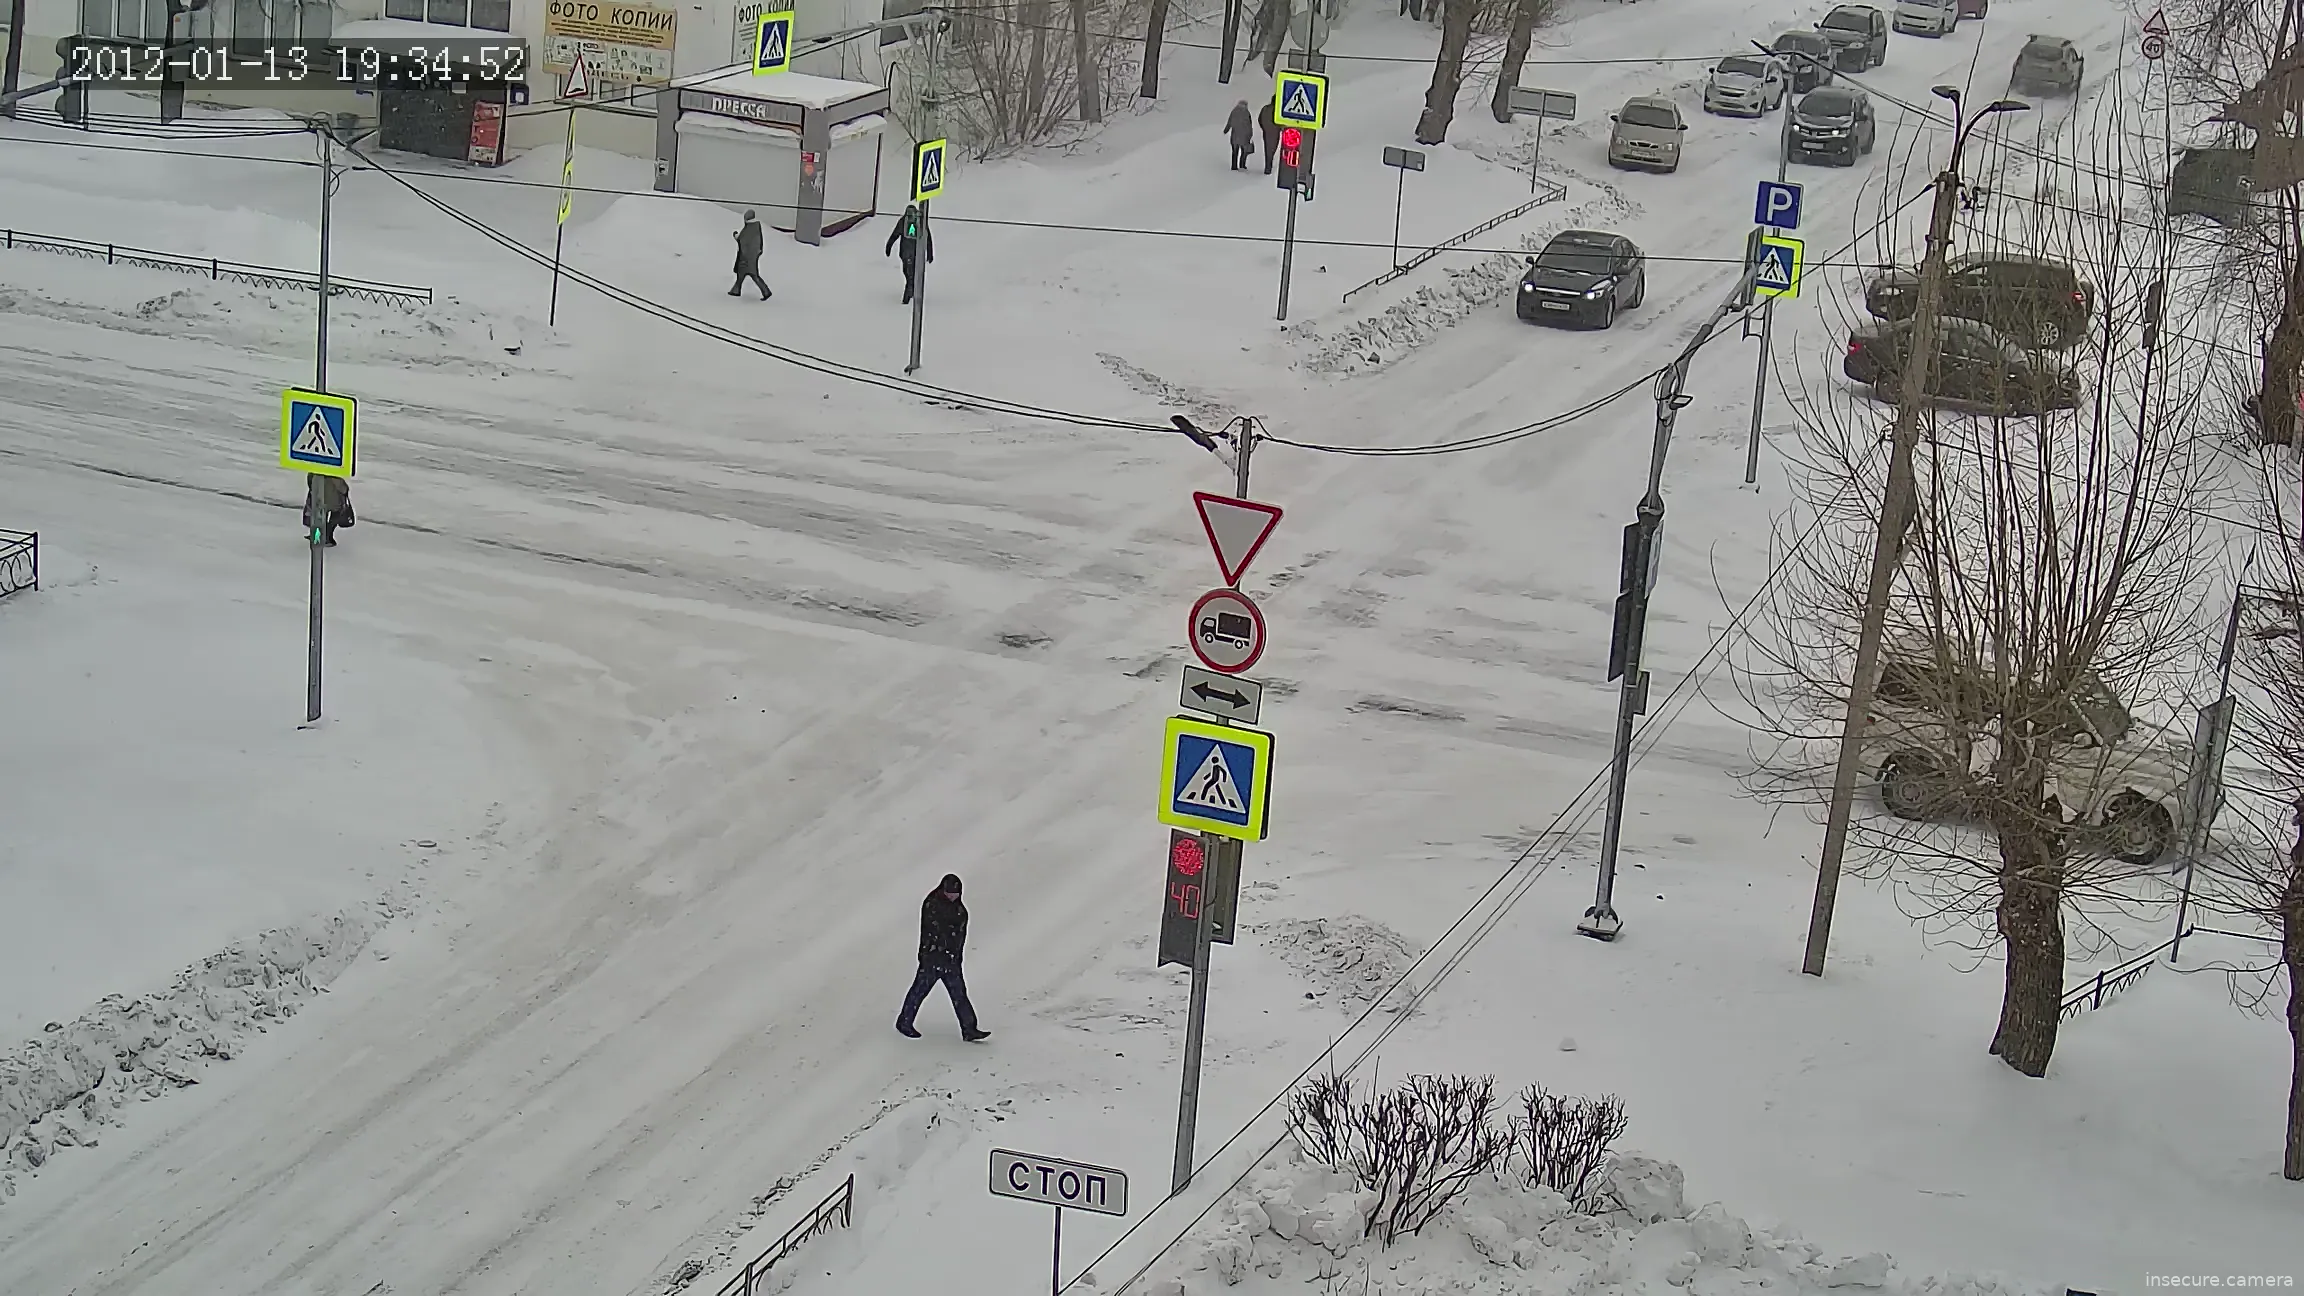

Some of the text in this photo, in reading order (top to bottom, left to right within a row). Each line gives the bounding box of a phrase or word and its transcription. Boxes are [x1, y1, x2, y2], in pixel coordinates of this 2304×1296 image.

[550, 0, 673, 30] ФОТО КОПИИ
[1766, 187, 1793, 222] P
[1171, 881, 1201, 919] 40
[1008, 1162, 1106, 1206] СТОП
